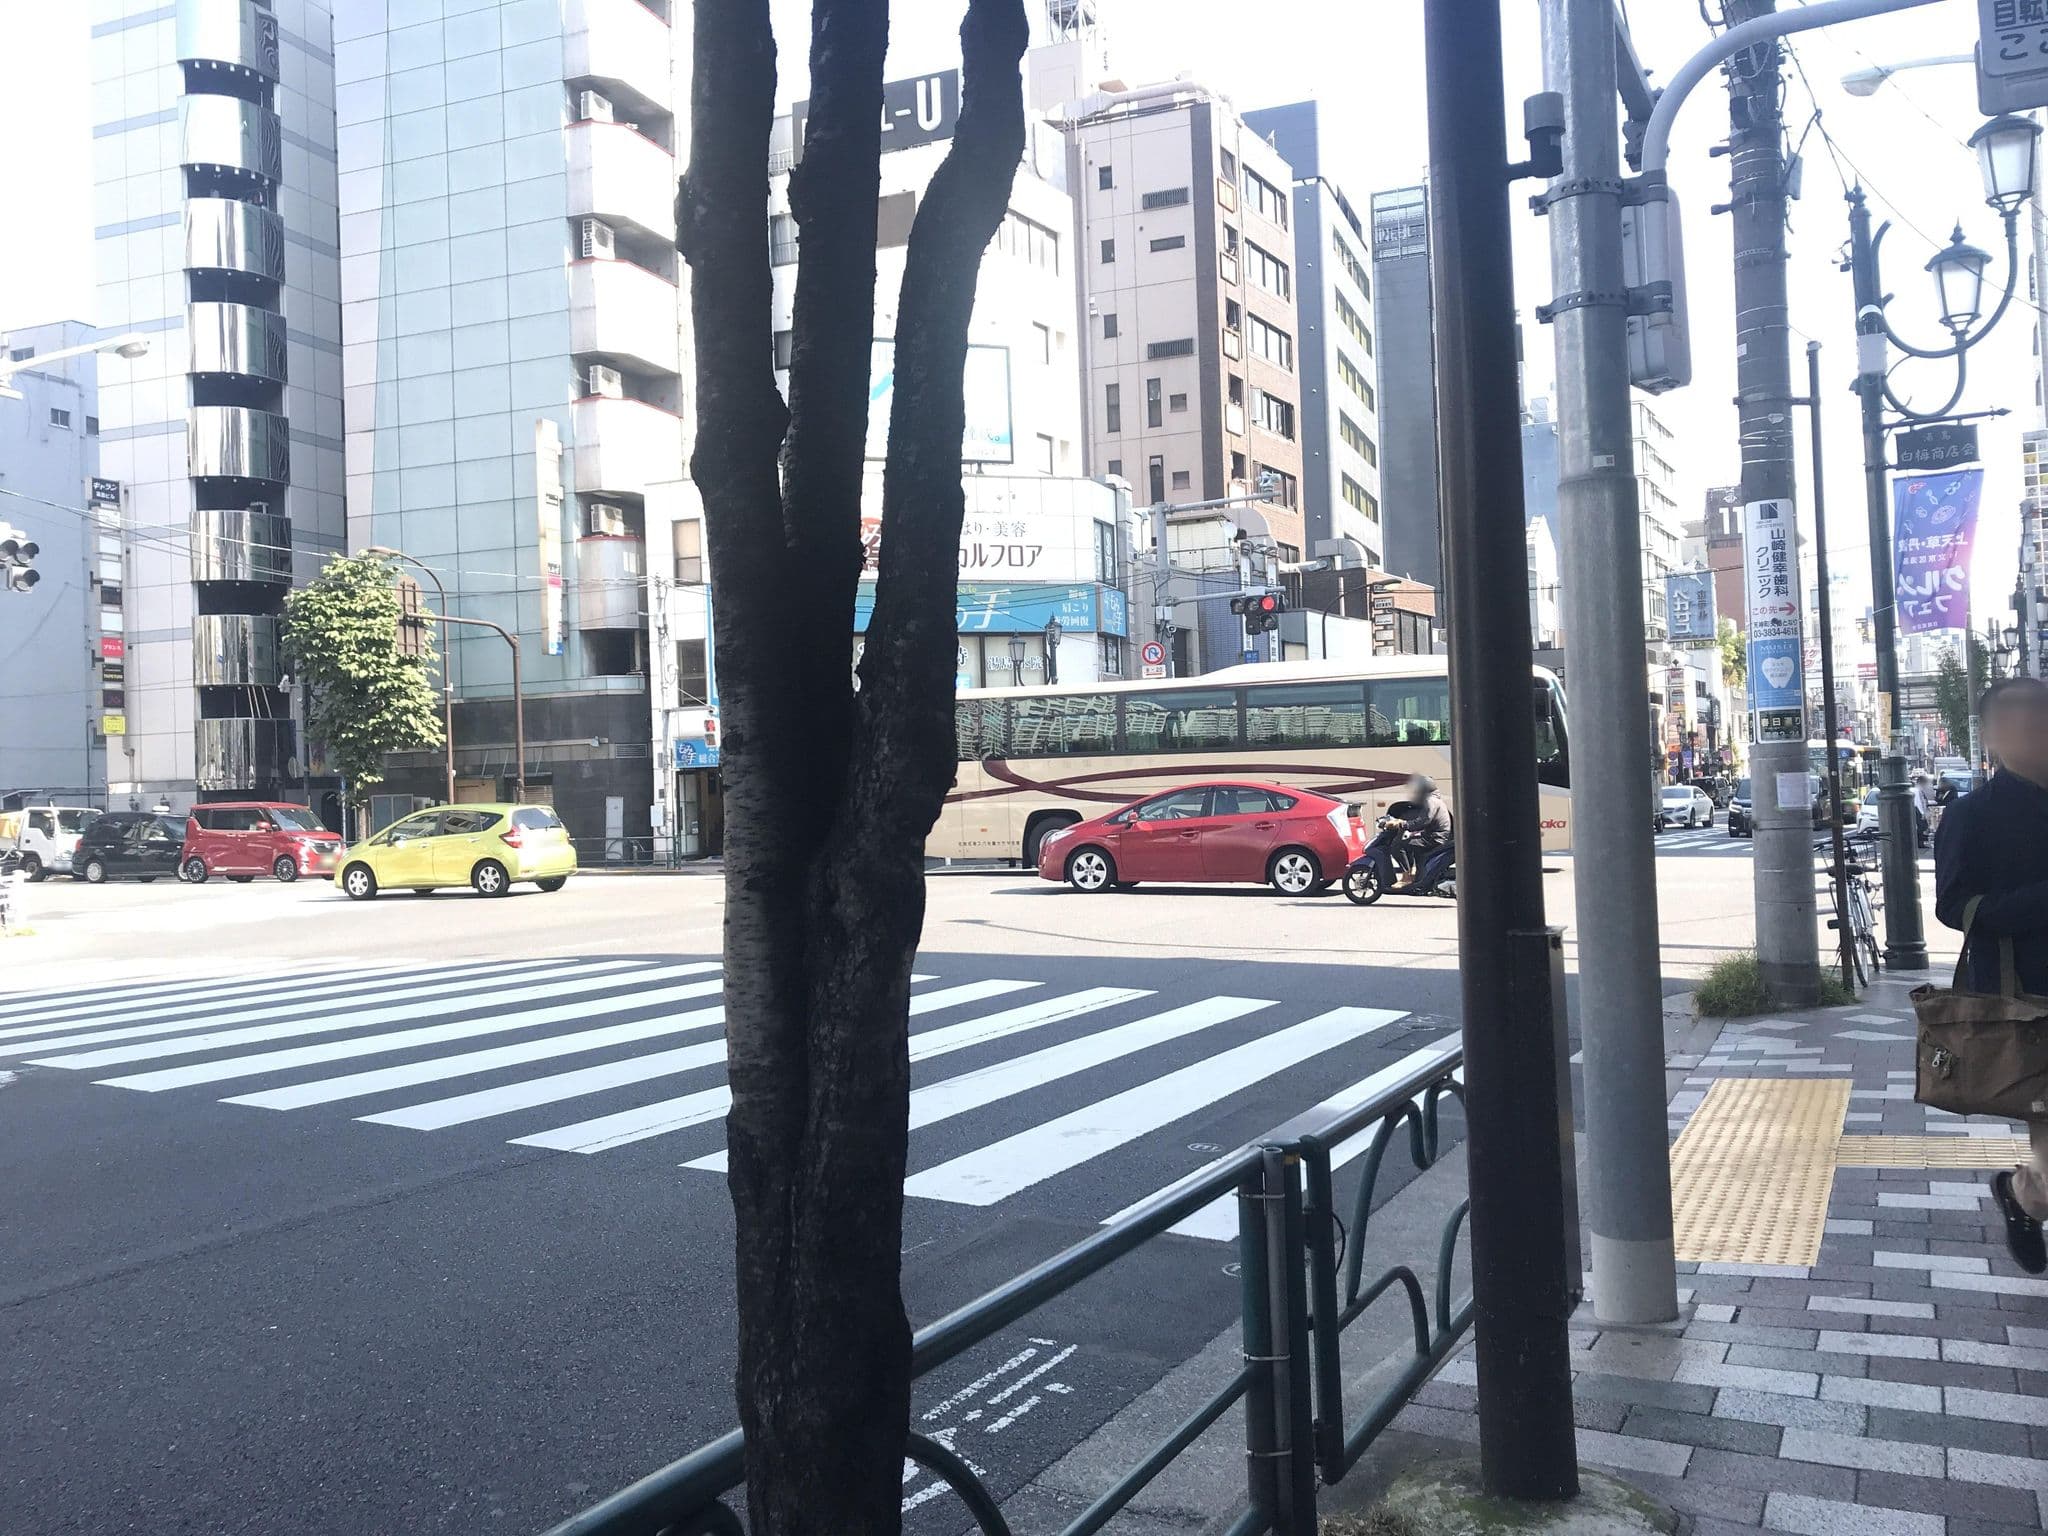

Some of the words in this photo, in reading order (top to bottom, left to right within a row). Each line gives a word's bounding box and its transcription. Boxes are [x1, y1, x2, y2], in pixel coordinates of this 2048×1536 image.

[1993, 0, 2048, 27] 自転
[1901, 443, 1976, 462] 白梅商店会
[1756, 546, 1772, 599] クリニック
[1062, 603, 1089, 613] 肩こり
[1752, 606, 1778, 616] この先
